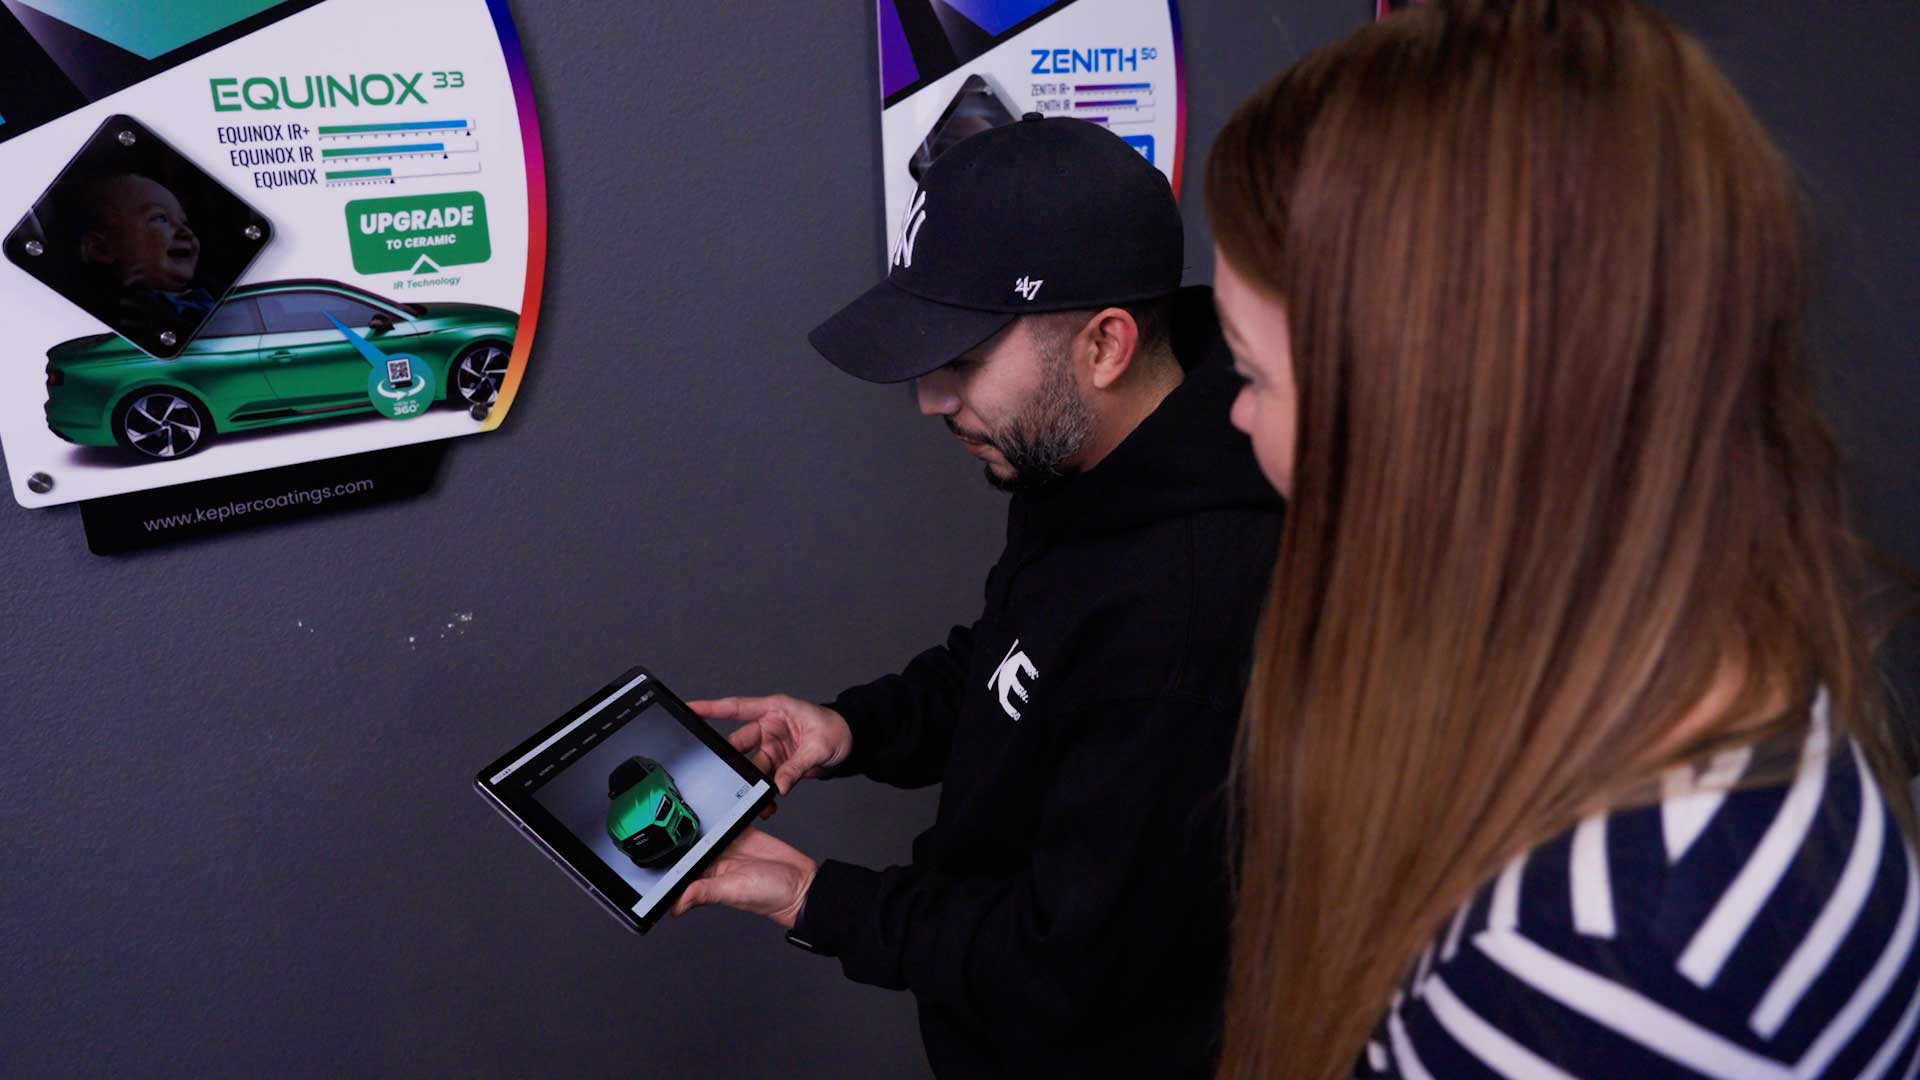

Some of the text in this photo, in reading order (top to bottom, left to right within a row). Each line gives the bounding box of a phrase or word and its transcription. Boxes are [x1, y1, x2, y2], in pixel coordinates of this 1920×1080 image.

[1031, 47, 1157, 74] ZENITH 50
[209, 71, 465, 112] EQUINOX 33
[217, 124, 284, 145] EQUINOX
[287, 123, 310, 140] IR+
[230, 147, 295, 168] EQUINOX
[299, 146, 314, 162] IR
[254, 168, 318, 190] EQUINOX
[360, 205, 474, 235] UPGRADE
[385, 234, 457, 250] TO CERAMIC
[393, 276, 461, 290] IR Technology
[143, 479, 375, 532] www.keplercoatings.com
